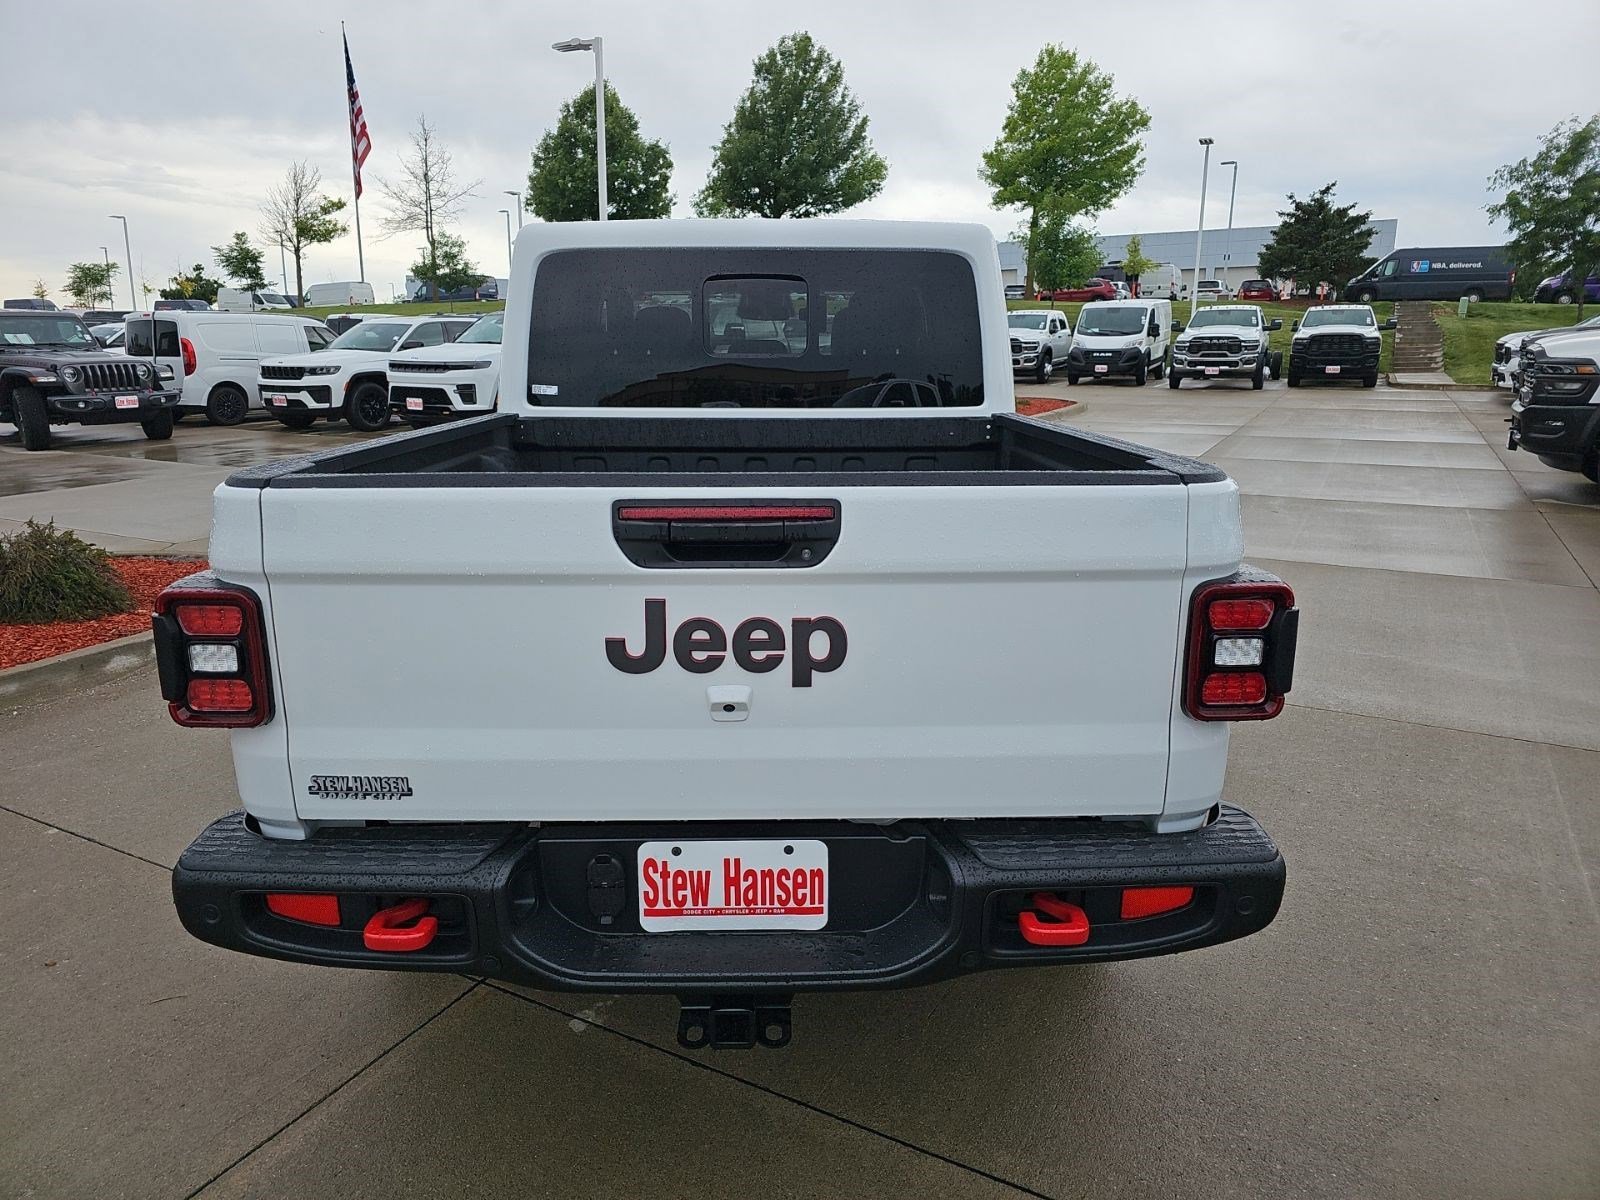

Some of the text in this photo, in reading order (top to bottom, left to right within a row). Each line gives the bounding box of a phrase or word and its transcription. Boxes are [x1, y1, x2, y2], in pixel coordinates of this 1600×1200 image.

[604, 598, 848, 688] Jeep
[310, 775, 410, 792] STEW HANSEN
[320, 792, 401, 800] DODGE CITY
[643, 857, 825, 908] Stew Hansen
